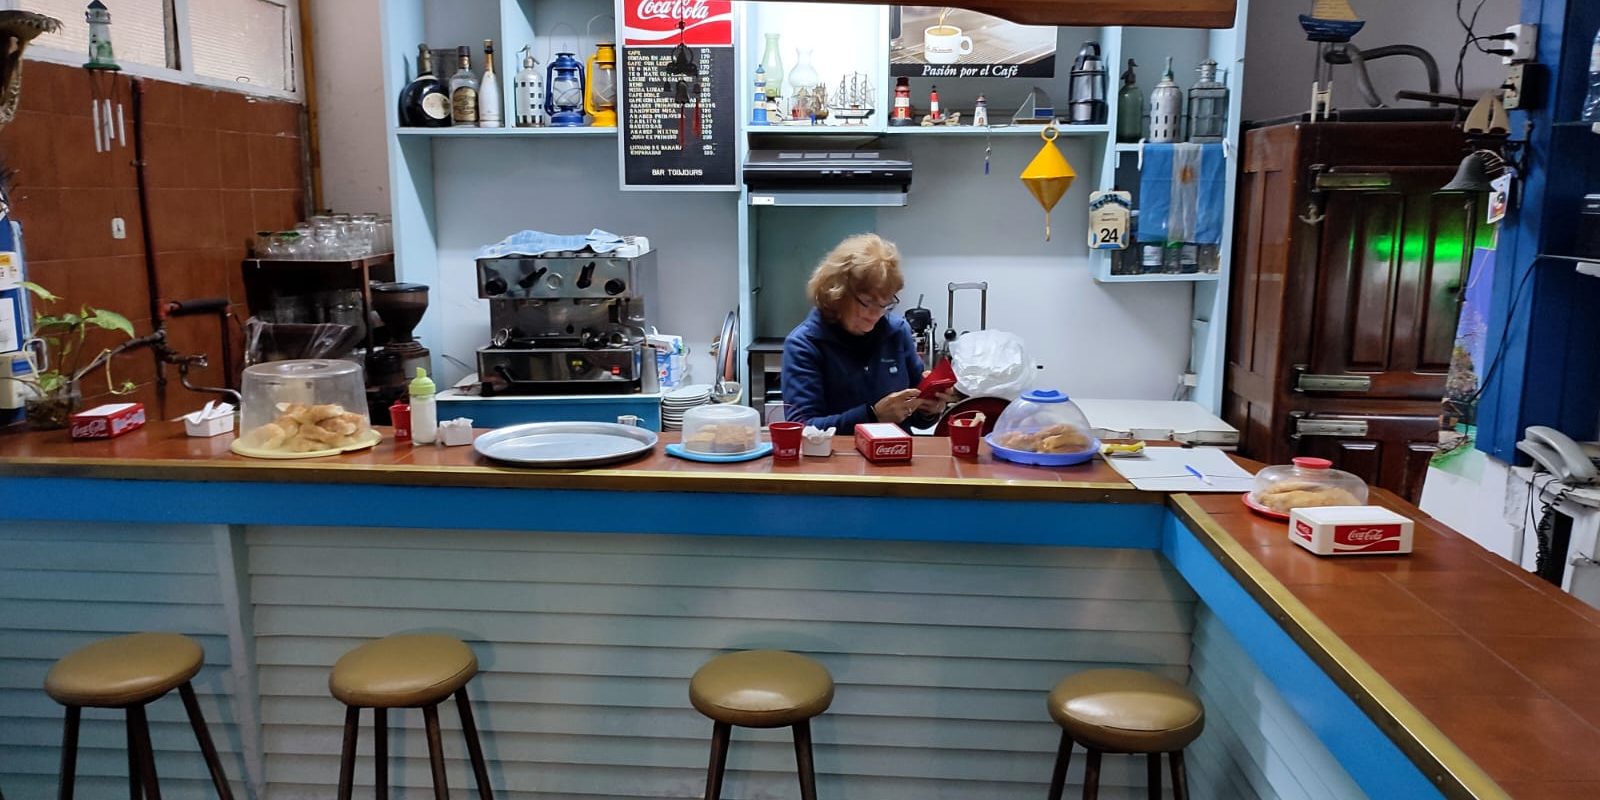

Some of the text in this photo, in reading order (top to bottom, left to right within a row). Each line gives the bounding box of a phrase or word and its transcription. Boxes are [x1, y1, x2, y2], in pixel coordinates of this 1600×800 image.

[636, 0, 710, 20] Coca-Cola
[921, 64, 1019, 79] Pasión por el Café
[1100, 228, 1118, 243] 24
[1347, 528, 1384, 542] Coca-Cola
